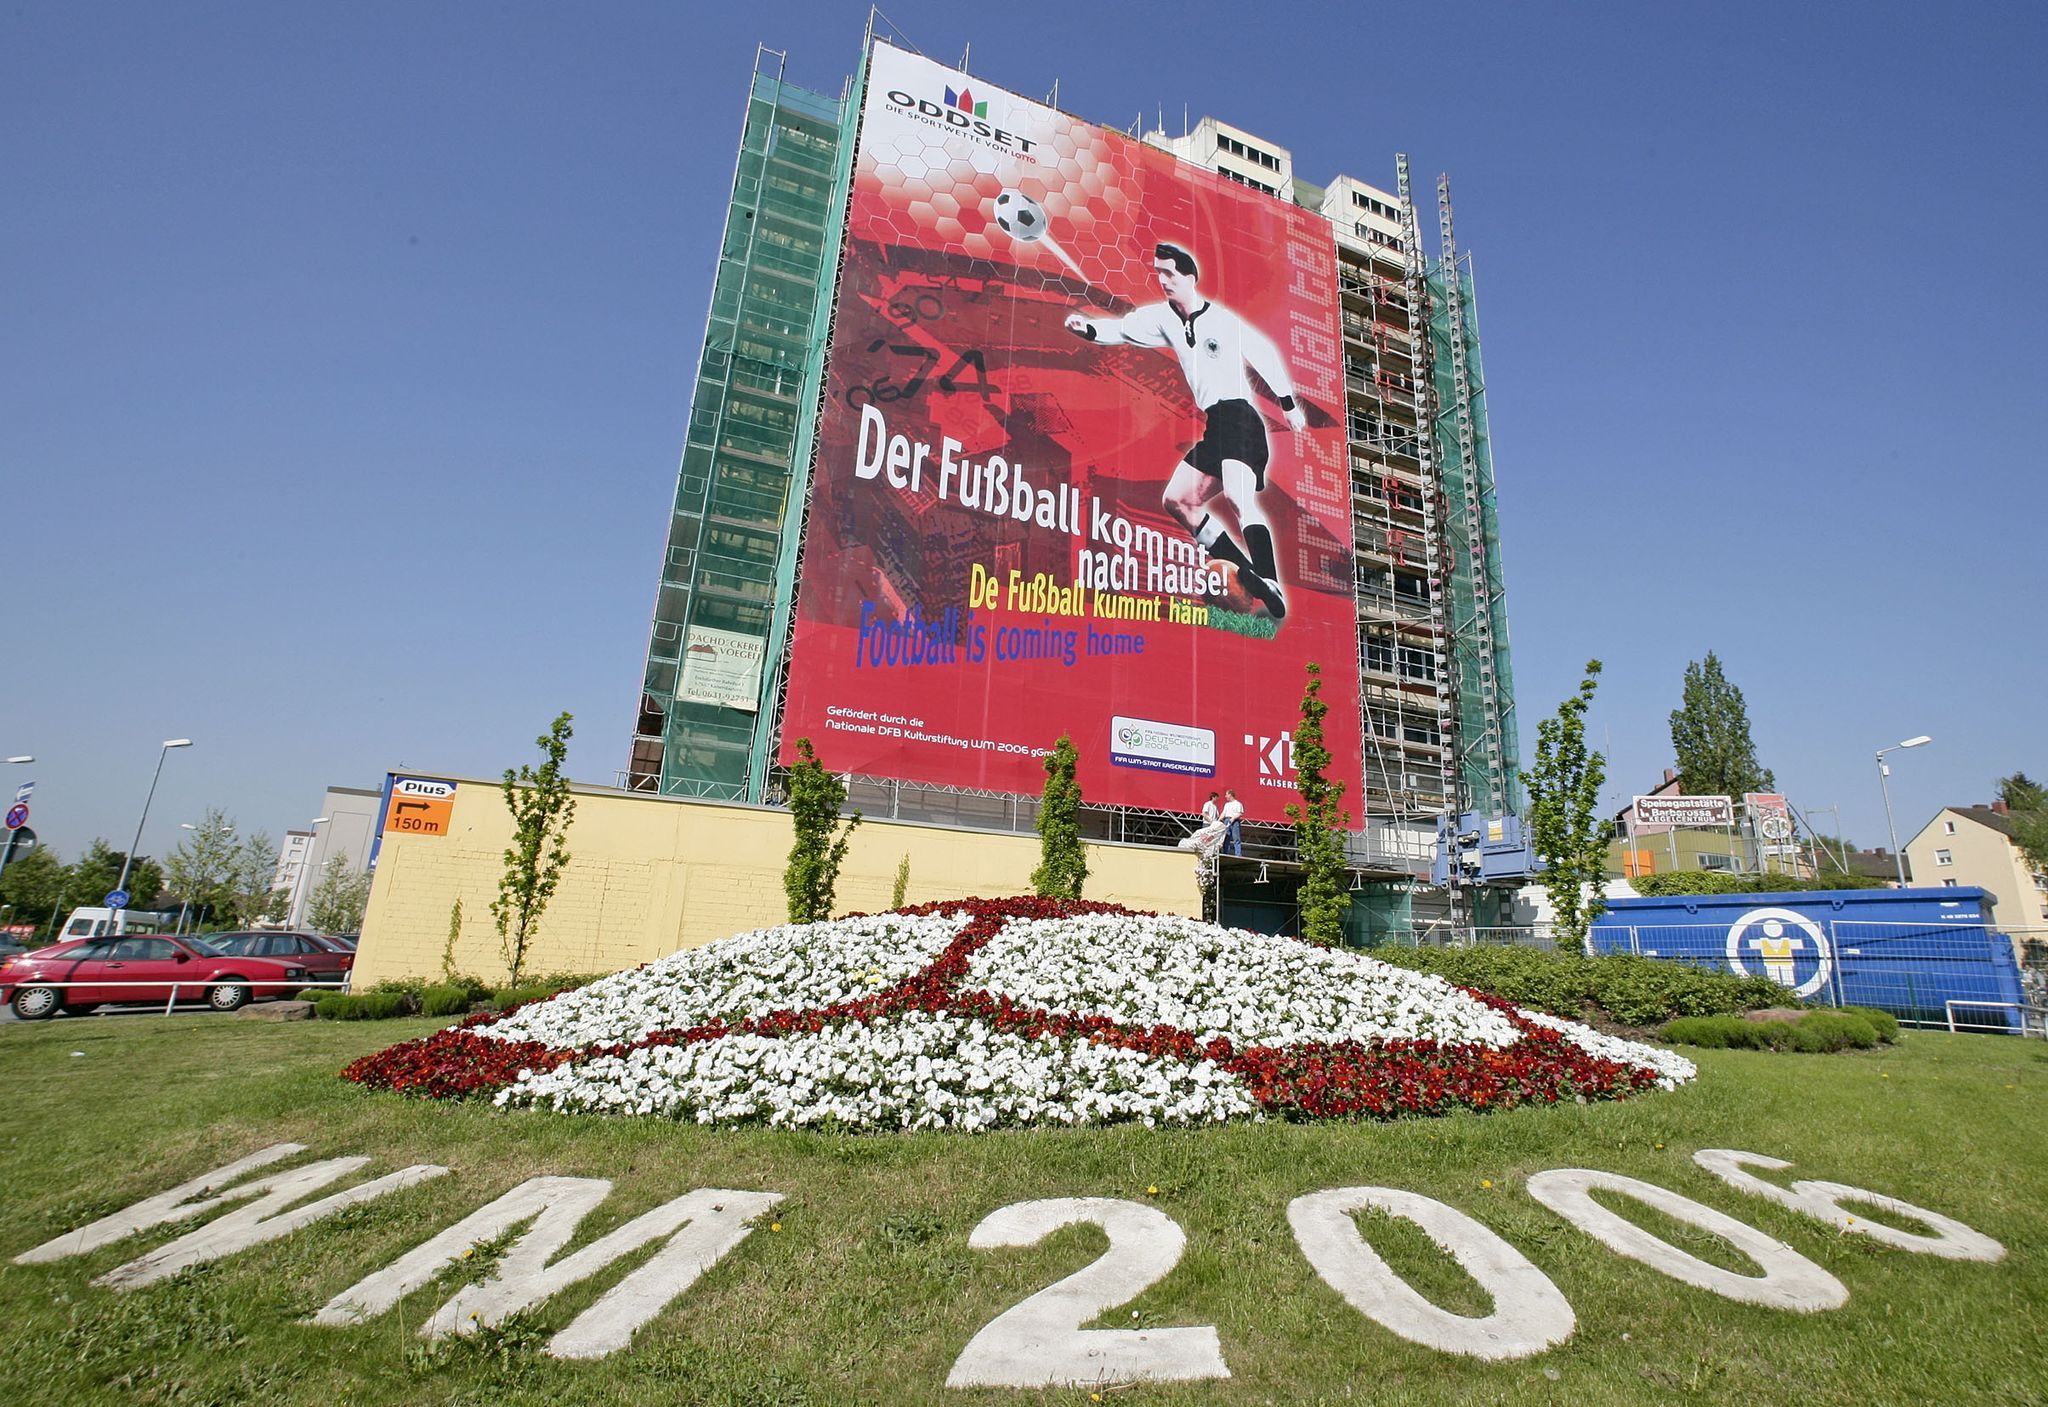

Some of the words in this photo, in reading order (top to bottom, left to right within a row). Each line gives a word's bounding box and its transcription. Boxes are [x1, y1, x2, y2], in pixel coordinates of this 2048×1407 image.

[885, 104, 904, 116] DIE
[907, 112, 981, 144] SPORTWETTE
[985, 140, 1008, 154] VON
[1011, 151, 1036, 164] LOTTO
[887, 91, 1037, 153] ODDSET
[855, 403, 930, 493] Der
[938, 435, 1081, 537] Fußball
[1091, 496, 1210, 570] kommt
[1078, 548, 1139, 591] nach
[1147, 550, 1229, 596] Hause!
[969, 562, 999, 610] De
[1007, 569, 1086, 616] Fußball
[1093, 589, 1161, 622] kummt
[1168, 595, 1209, 626] häm
[688, 633, 763, 652] DACHDCKEREI
[856, 600, 959, 668] Football
[966, 611, 986, 663] is
[995, 618, 1078, 667] coming
[1087, 623, 1145, 656] home
[825, 719, 876, 735] Nationale
[878, 726, 902, 737] DFB
[904, 729, 968, 749] Kulturstiftung
[971, 739, 996, 750] WM
[997, 743, 1029, 754] 2006
[826, 705, 878, 721] Gefördert
[879, 713, 907, 725] durch
[909, 718, 925, 728] die
[1144, 734, 1210, 750] DEUTSCHLAND
[405, 783, 446, 795] Plus
[1640, 799, 1724, 810] Speisegaststätte
[394, 817, 421, 830] 150
[424, 821, 438, 832] m
[12, 1142, 785, 1358] WM
[945, 1149, 2008, 1389] 2006
